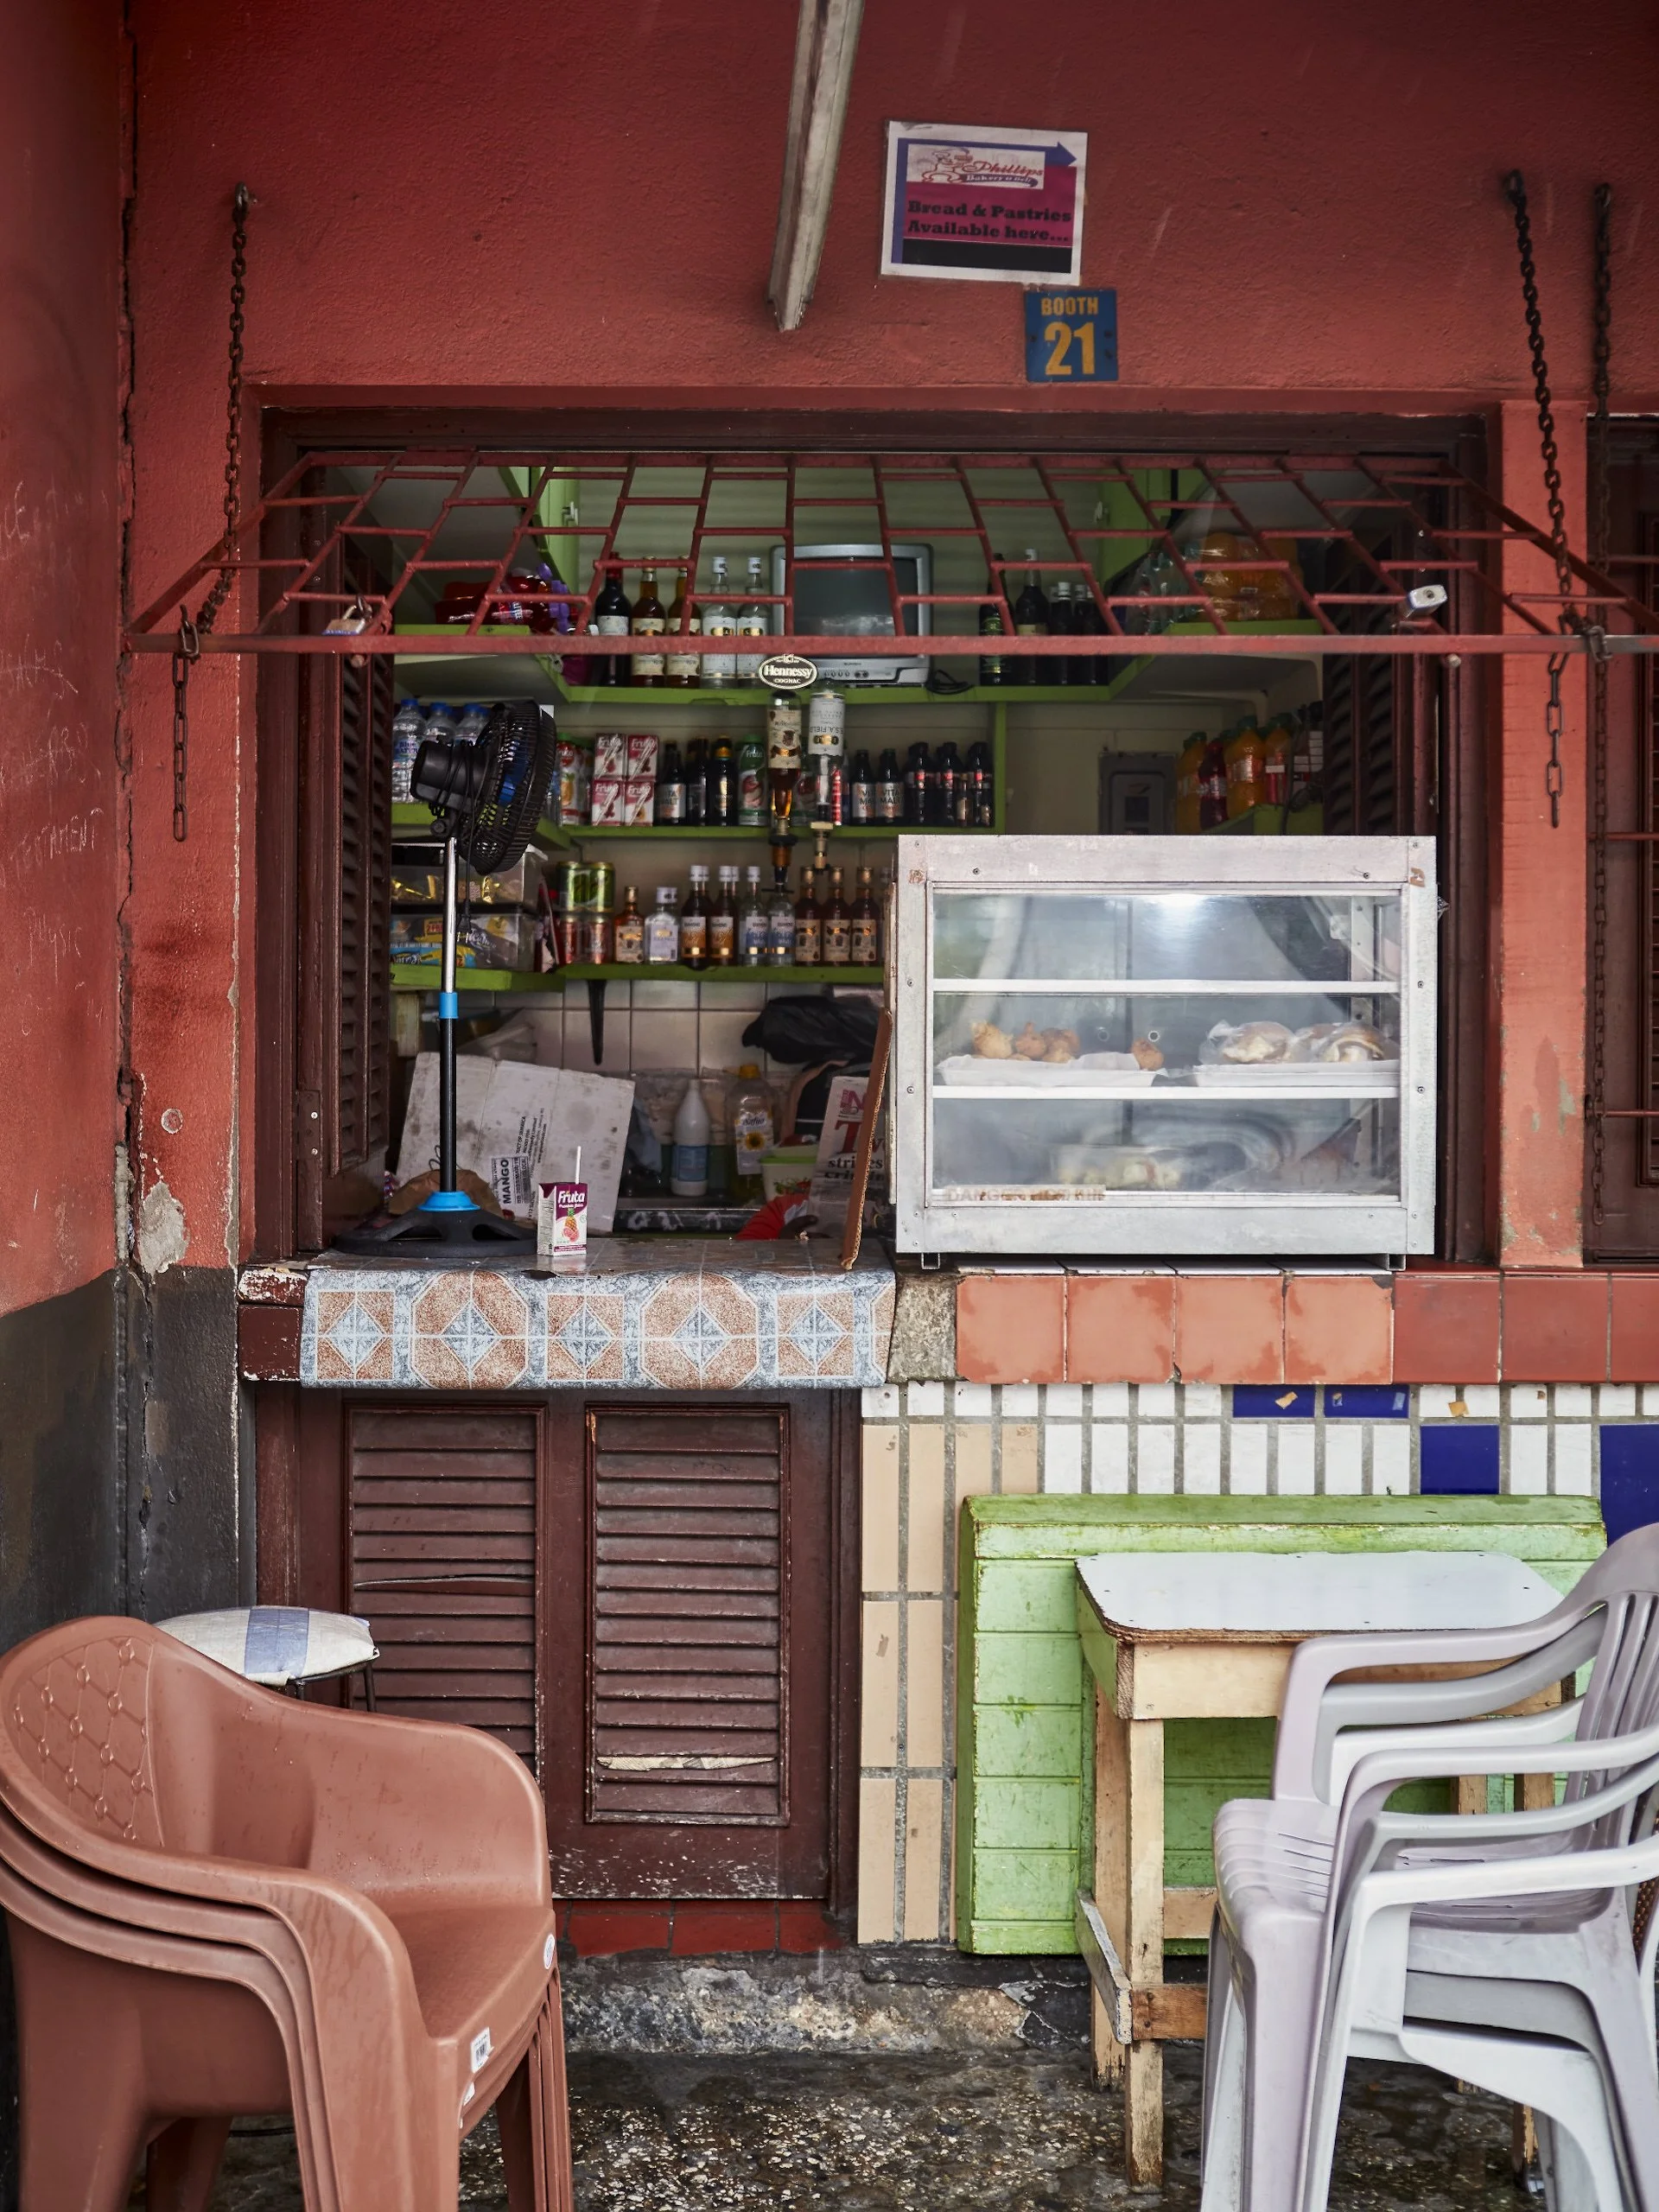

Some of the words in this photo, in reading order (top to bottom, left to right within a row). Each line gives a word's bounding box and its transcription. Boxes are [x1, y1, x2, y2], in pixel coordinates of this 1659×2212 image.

[963, 161, 1044, 177] Phillips
[965, 174, 1001, 182] Bakery
[907, 200, 967, 216] Bread
[973, 205, 987, 217] &
[991, 206, 1072, 222] Pastries
[907, 219, 1000, 238] Available
[1004, 226, 1069, 241] here...
[1041, 296, 1098, 315] BOOTH
[1044, 321, 1096, 375] 21
[764, 665, 813, 678] Hennessy
[828, 1155, 883, 1169] stries
[501, 1158, 511, 1205] MANGO
[558, 1190, 585, 1205] Fruta
